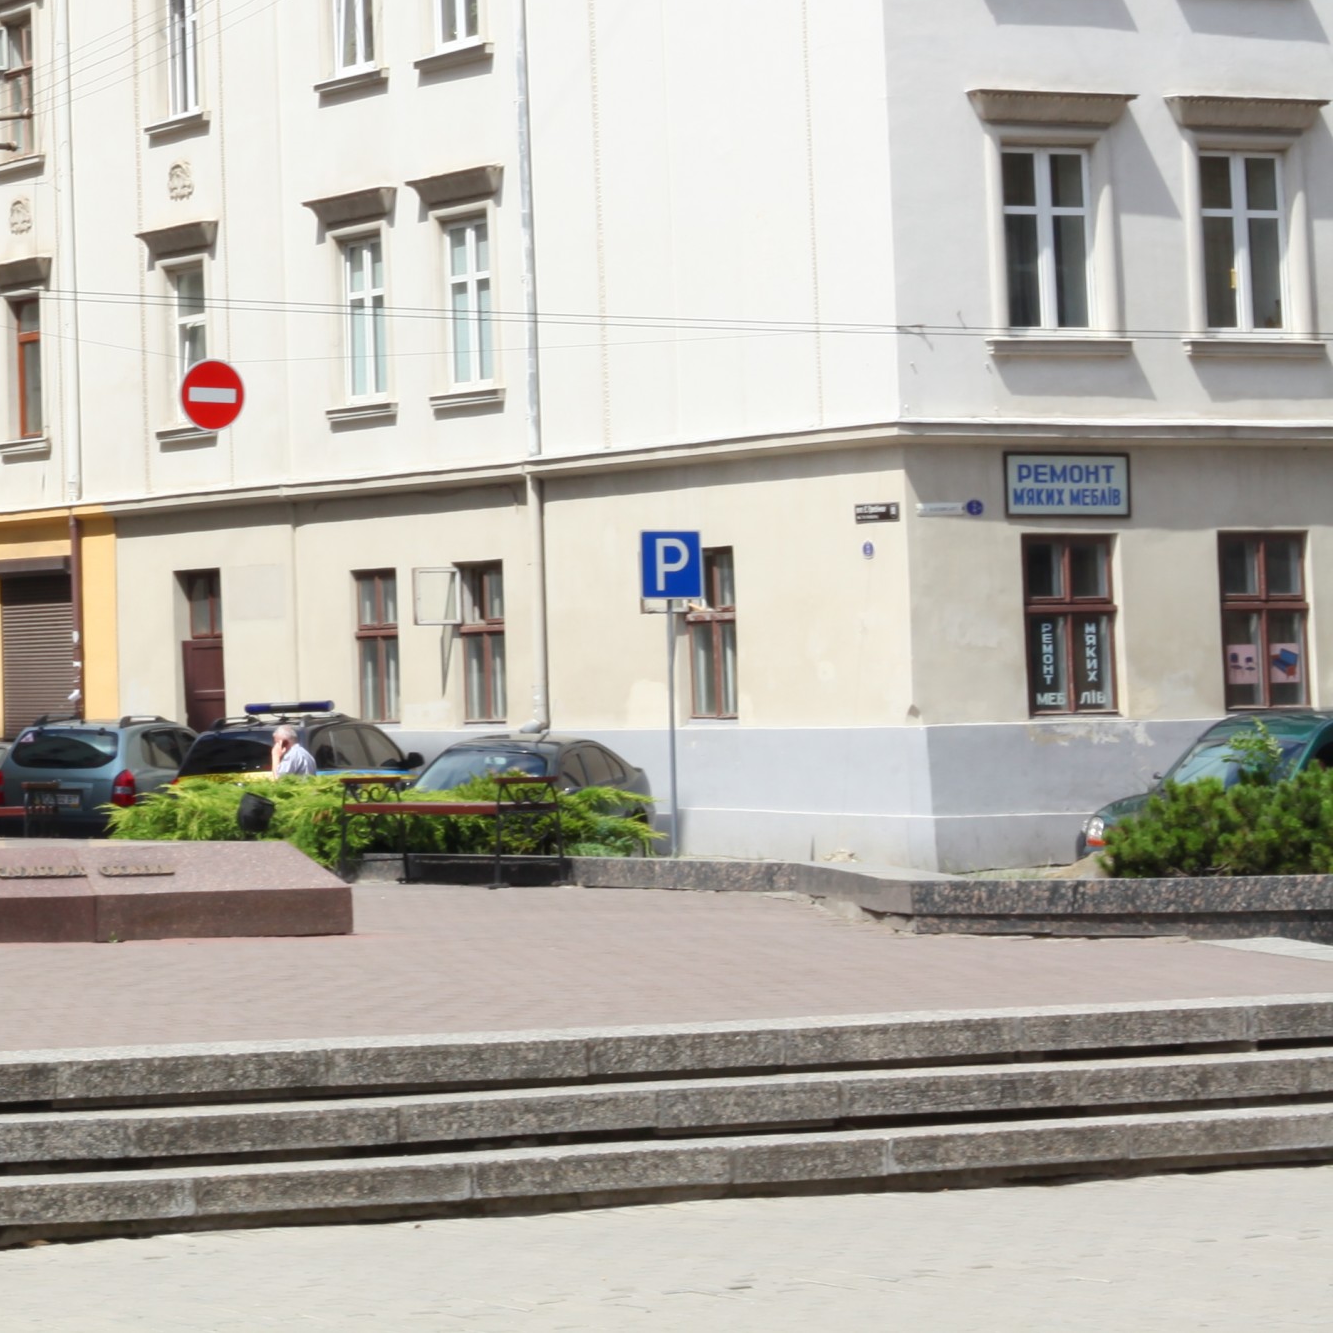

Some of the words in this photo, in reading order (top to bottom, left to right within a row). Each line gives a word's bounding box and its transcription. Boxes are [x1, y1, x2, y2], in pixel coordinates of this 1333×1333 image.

[1017, 464, 1116, 484] РЕМОНТ
[655, 538, 689, 591] P
[1041, 623, 1054, 685] РЕМОНТ
